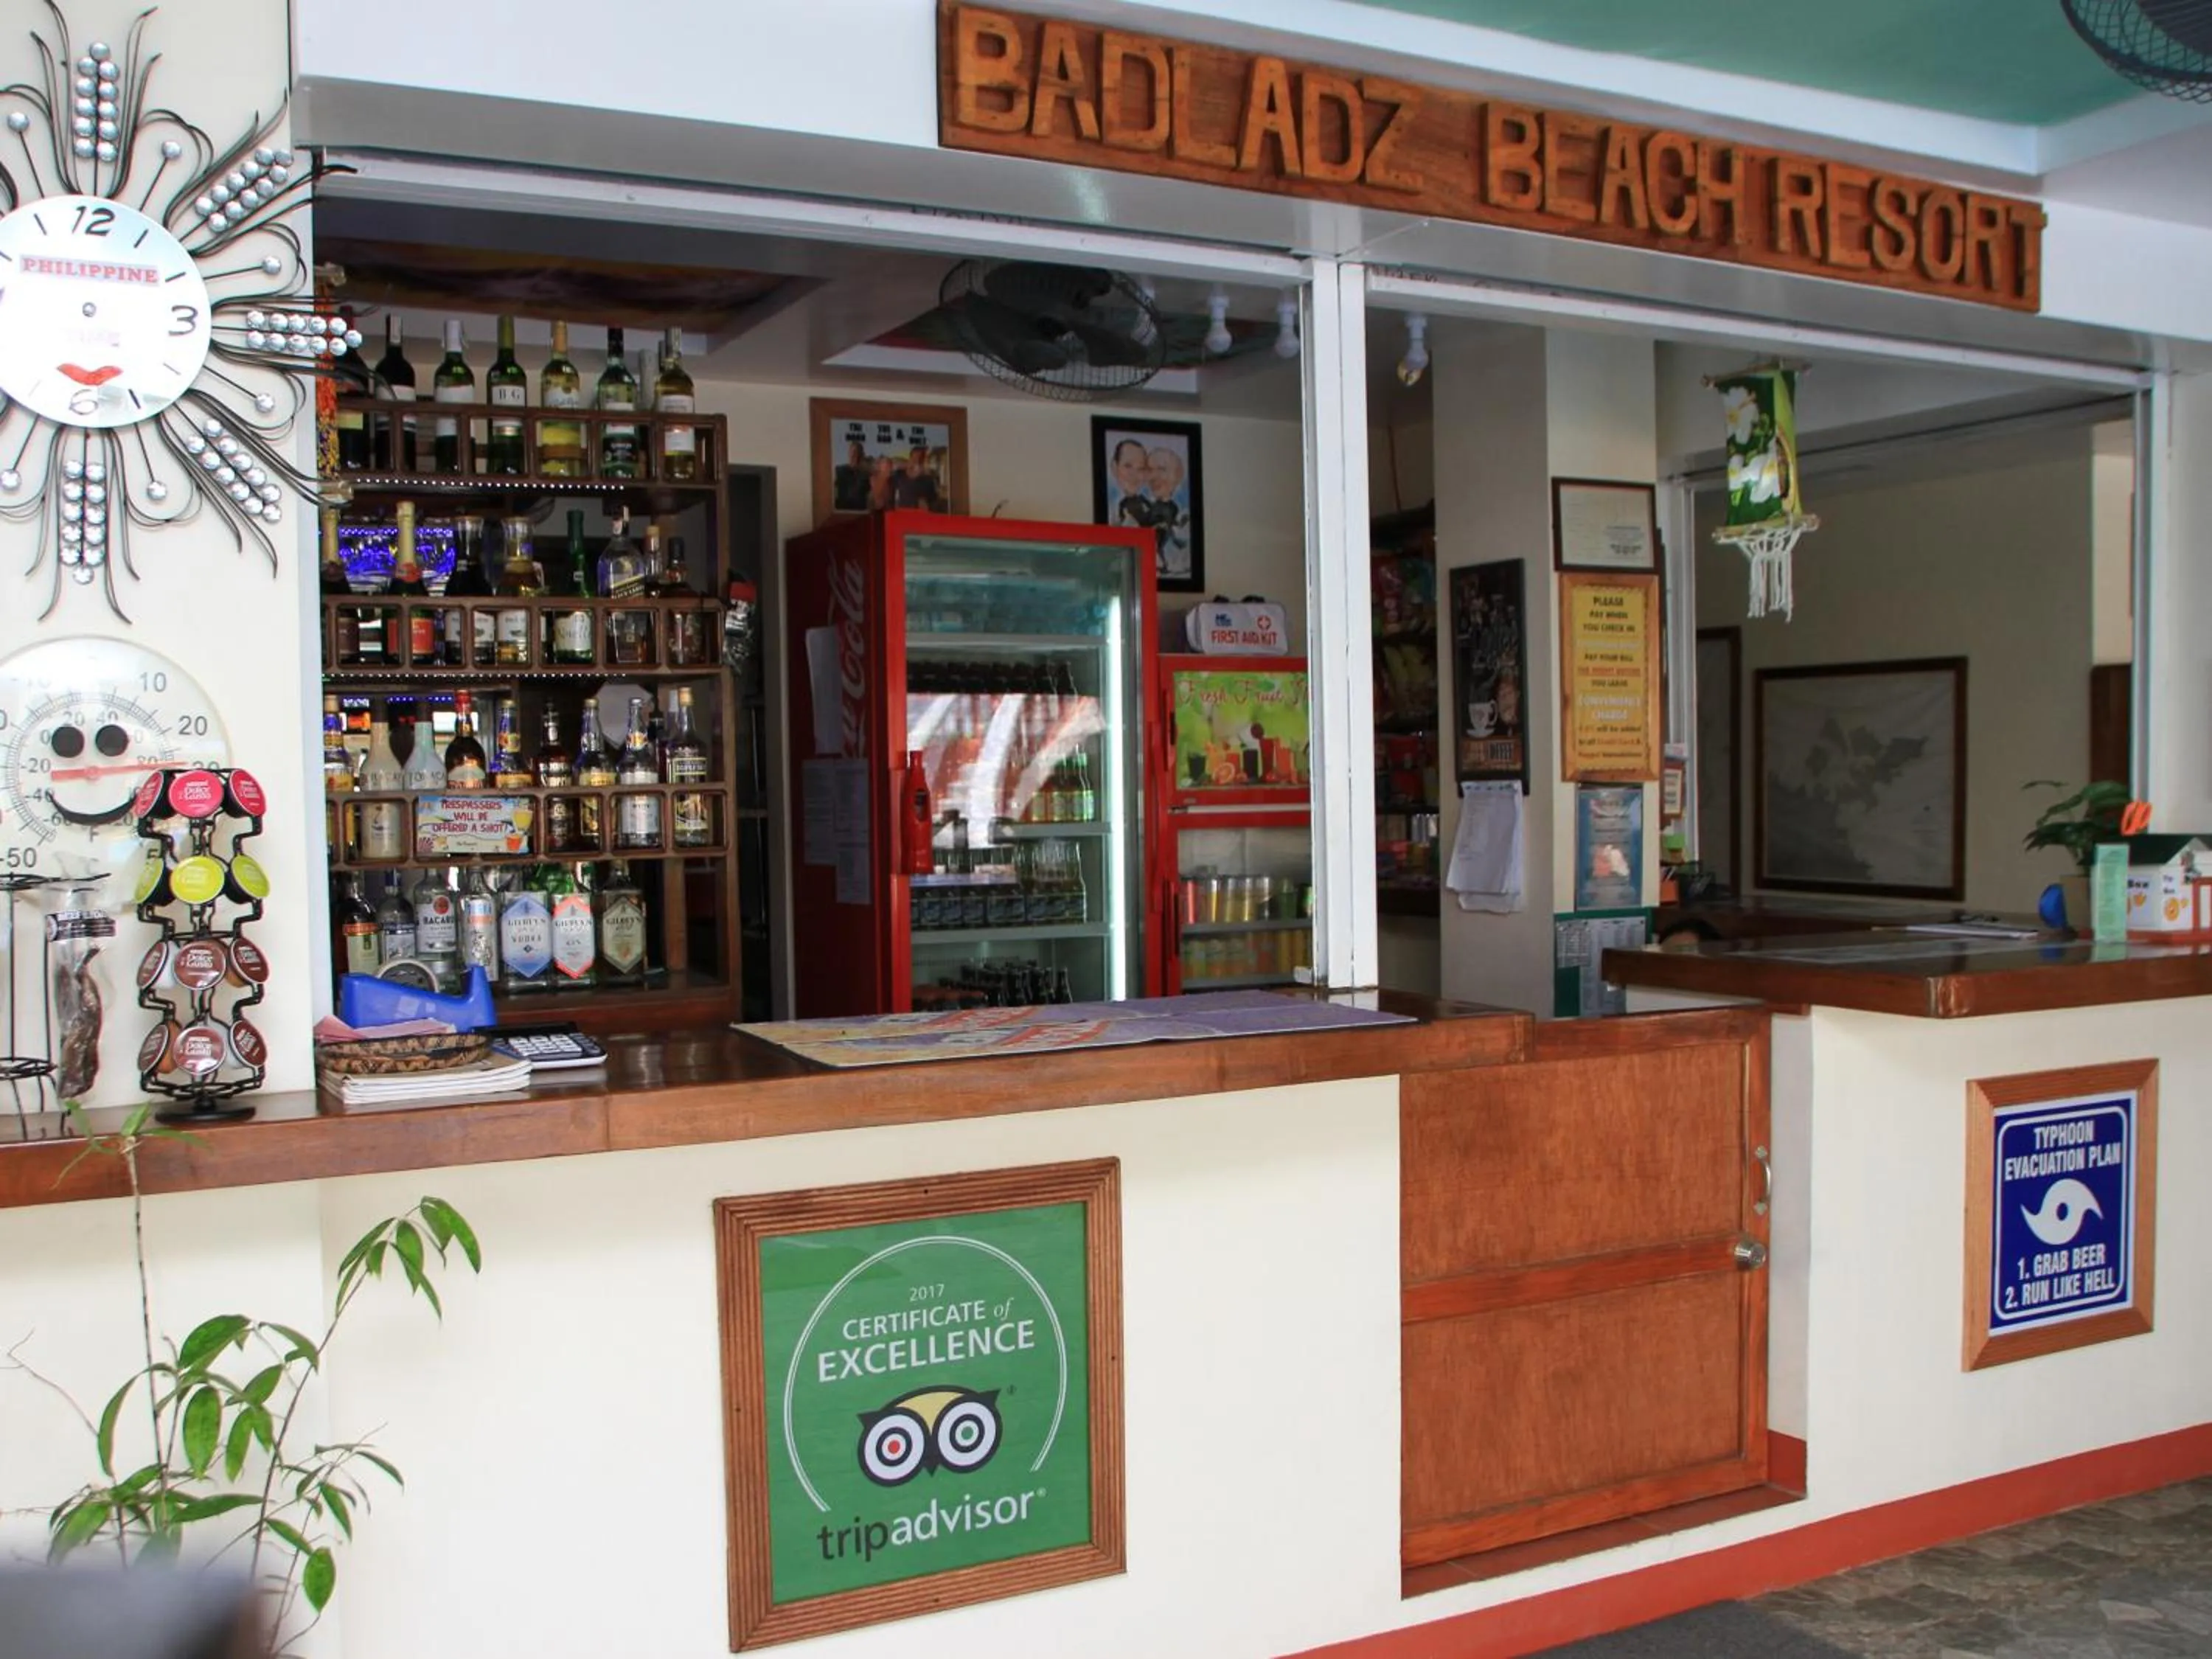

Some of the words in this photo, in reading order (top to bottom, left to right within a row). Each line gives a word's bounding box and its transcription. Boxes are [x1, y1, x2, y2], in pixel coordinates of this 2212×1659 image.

[957, 9, 1425, 193] BADLADZ
[1482, 100, 1745, 246] BEACH
[1774, 155, 2048, 301] RESORT
[72, 206, 115, 237] 12
[21, 257, 159, 283] PHILIPPINE
[168, 305, 198, 336] 3
[69, 389, 99, 416] 6
[1593, 596, 1624, 607] PLEASE
[1211, 630, 1239, 644] FIRST
[1242, 631, 1259, 645] AID
[1260, 632, 1278, 646] KIT
[140, 672, 167, 693] 10
[1178, 679, 1228, 704] Fresh
[1234, 679, 1284, 706] Fruit
[178, 715, 208, 736] 20
[21, 757, 52, 773] -20
[439, 799, 503, 810] TRESPASSERS
[453, 811, 476, 821] WILL
[478, 812, 488, 821] BE
[432, 823, 468, 833] OFFERED
[471, 824, 478, 833] A
[0, 848, 38, 869] -50
[422, 915, 455, 925] BACAR
[2034, 1120, 2094, 1150] TYPHOON
[2004, 1147, 2085, 1181] EVACUATION
[2088, 1142, 2122, 1169] PLAN
[2017, 1256, 2030, 1281] 1.
[2033, 1250, 2069, 1277] GRAB
[2072, 1243, 2106, 1269] BEER
[909, 1283, 945, 1302] 2017
[2005, 1287, 2018, 1310] 2.
[2022, 1280, 2050, 1305] RUN
[2053, 1273, 2080, 1298] LIKE
[2084, 1267, 2115, 1291] HELL
[842, 1300, 987, 1340] CERTIFICATE
[992, 1297, 1015, 1319] of
[817, 1319, 1036, 1383] EXCELLENCE
[815, 1492, 1035, 1562] tripadvisor
